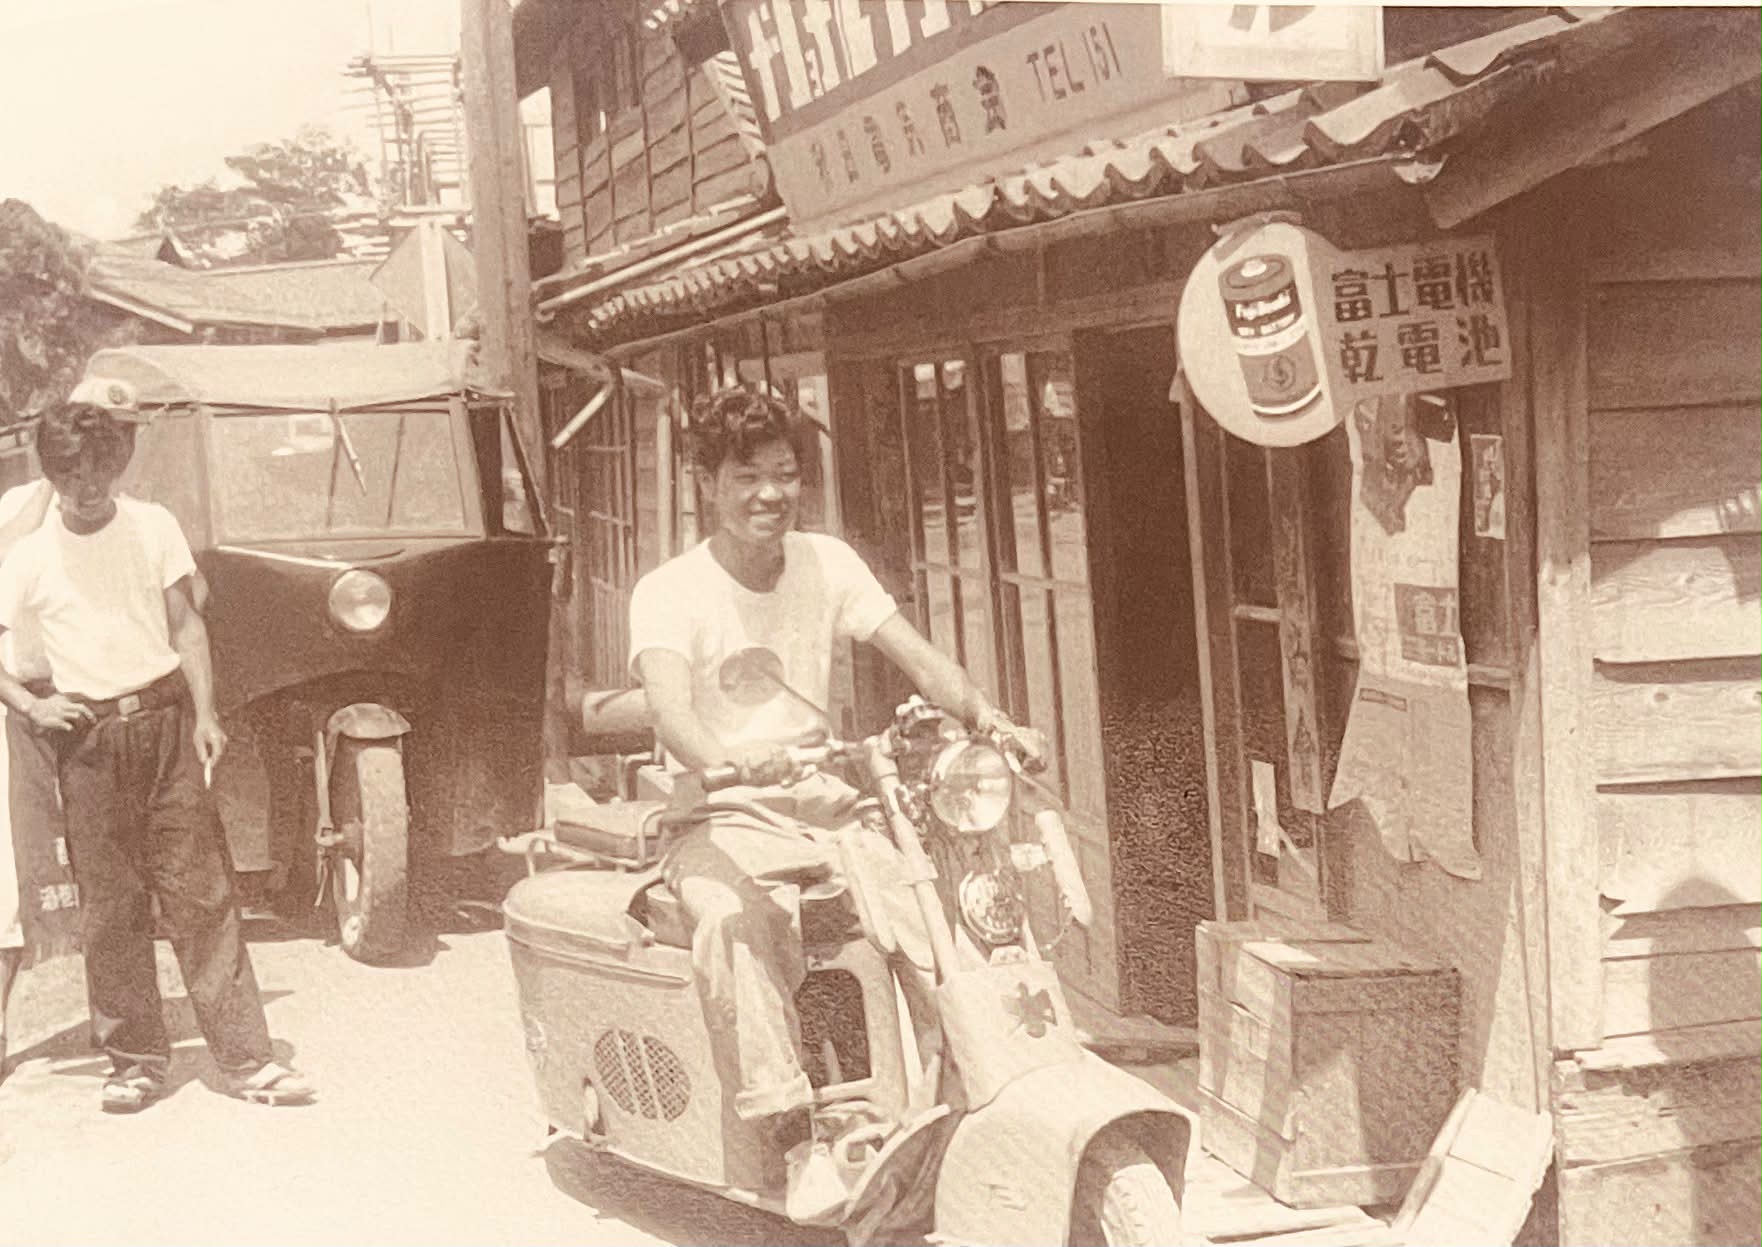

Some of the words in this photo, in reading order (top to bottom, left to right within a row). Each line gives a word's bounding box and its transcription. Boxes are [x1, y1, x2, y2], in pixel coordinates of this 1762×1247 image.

[1026, 40, 1085, 102] TEL
[1331, 250, 1495, 322] 富士電機
[1338, 313, 1504, 384] 乾電池
